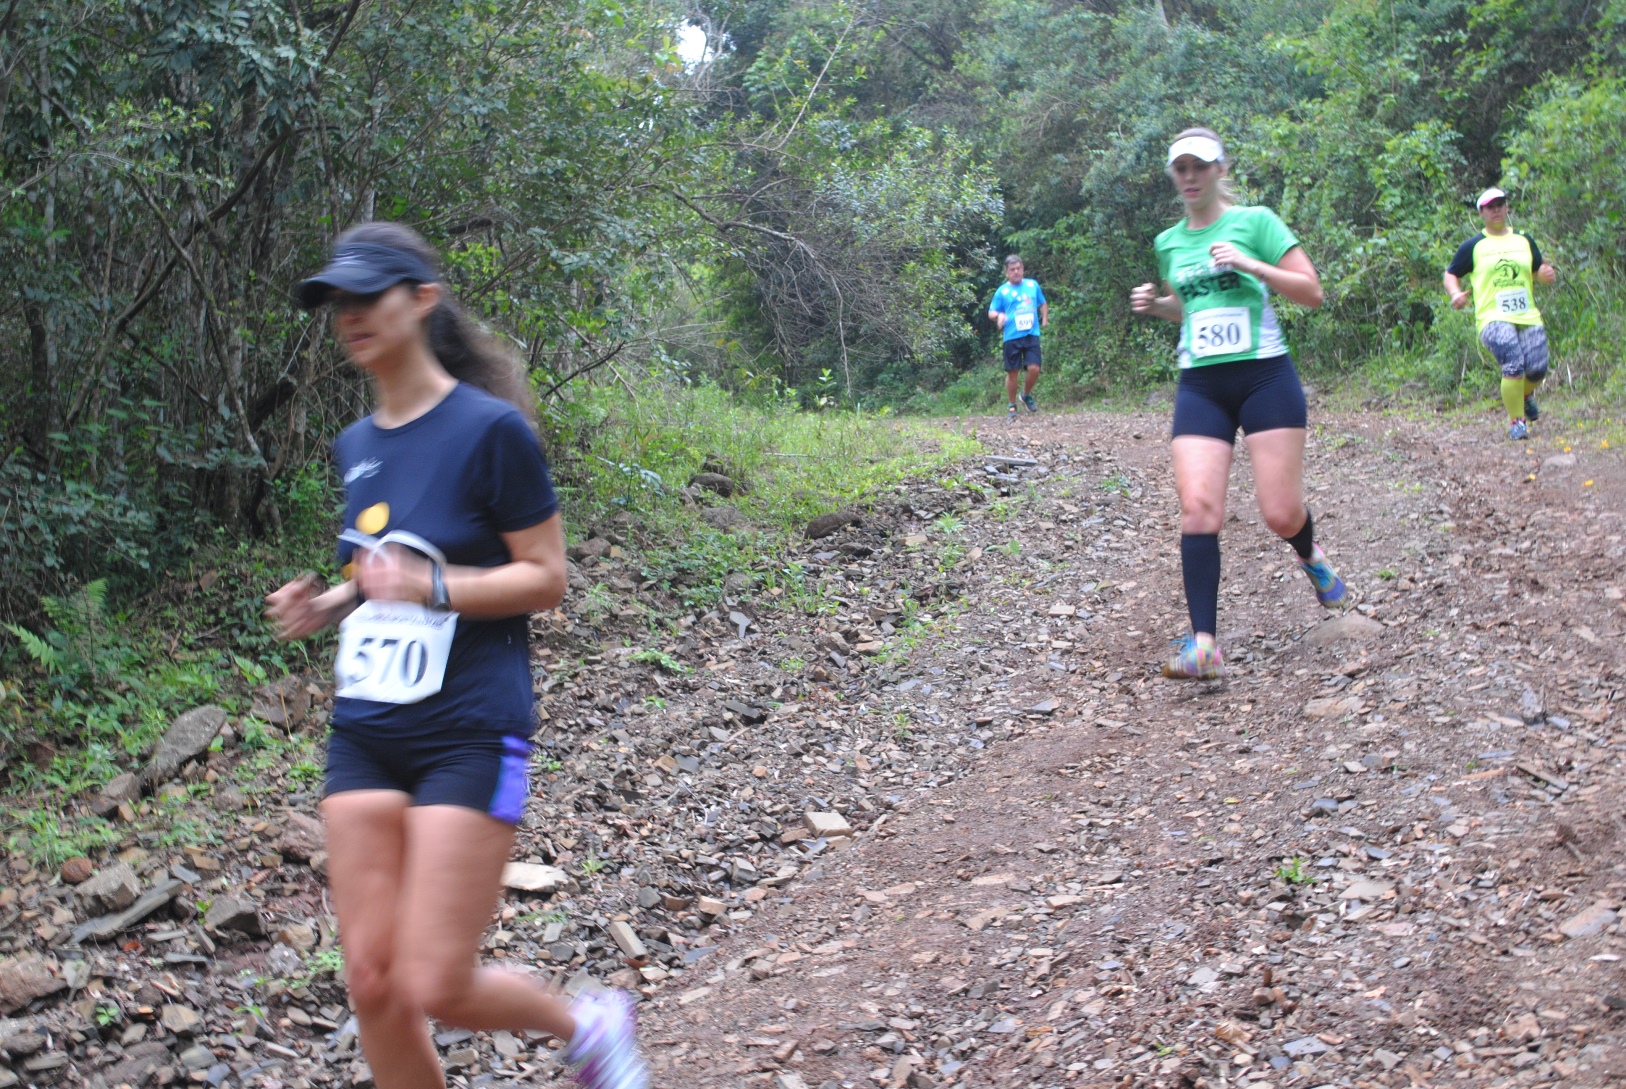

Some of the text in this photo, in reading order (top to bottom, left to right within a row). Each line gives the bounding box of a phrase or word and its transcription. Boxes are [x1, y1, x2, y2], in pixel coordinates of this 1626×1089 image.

[1502, 296, 1526, 312] 538
[1198, 322, 1241, 350] 580
[347, 637, 429, 688] 570
